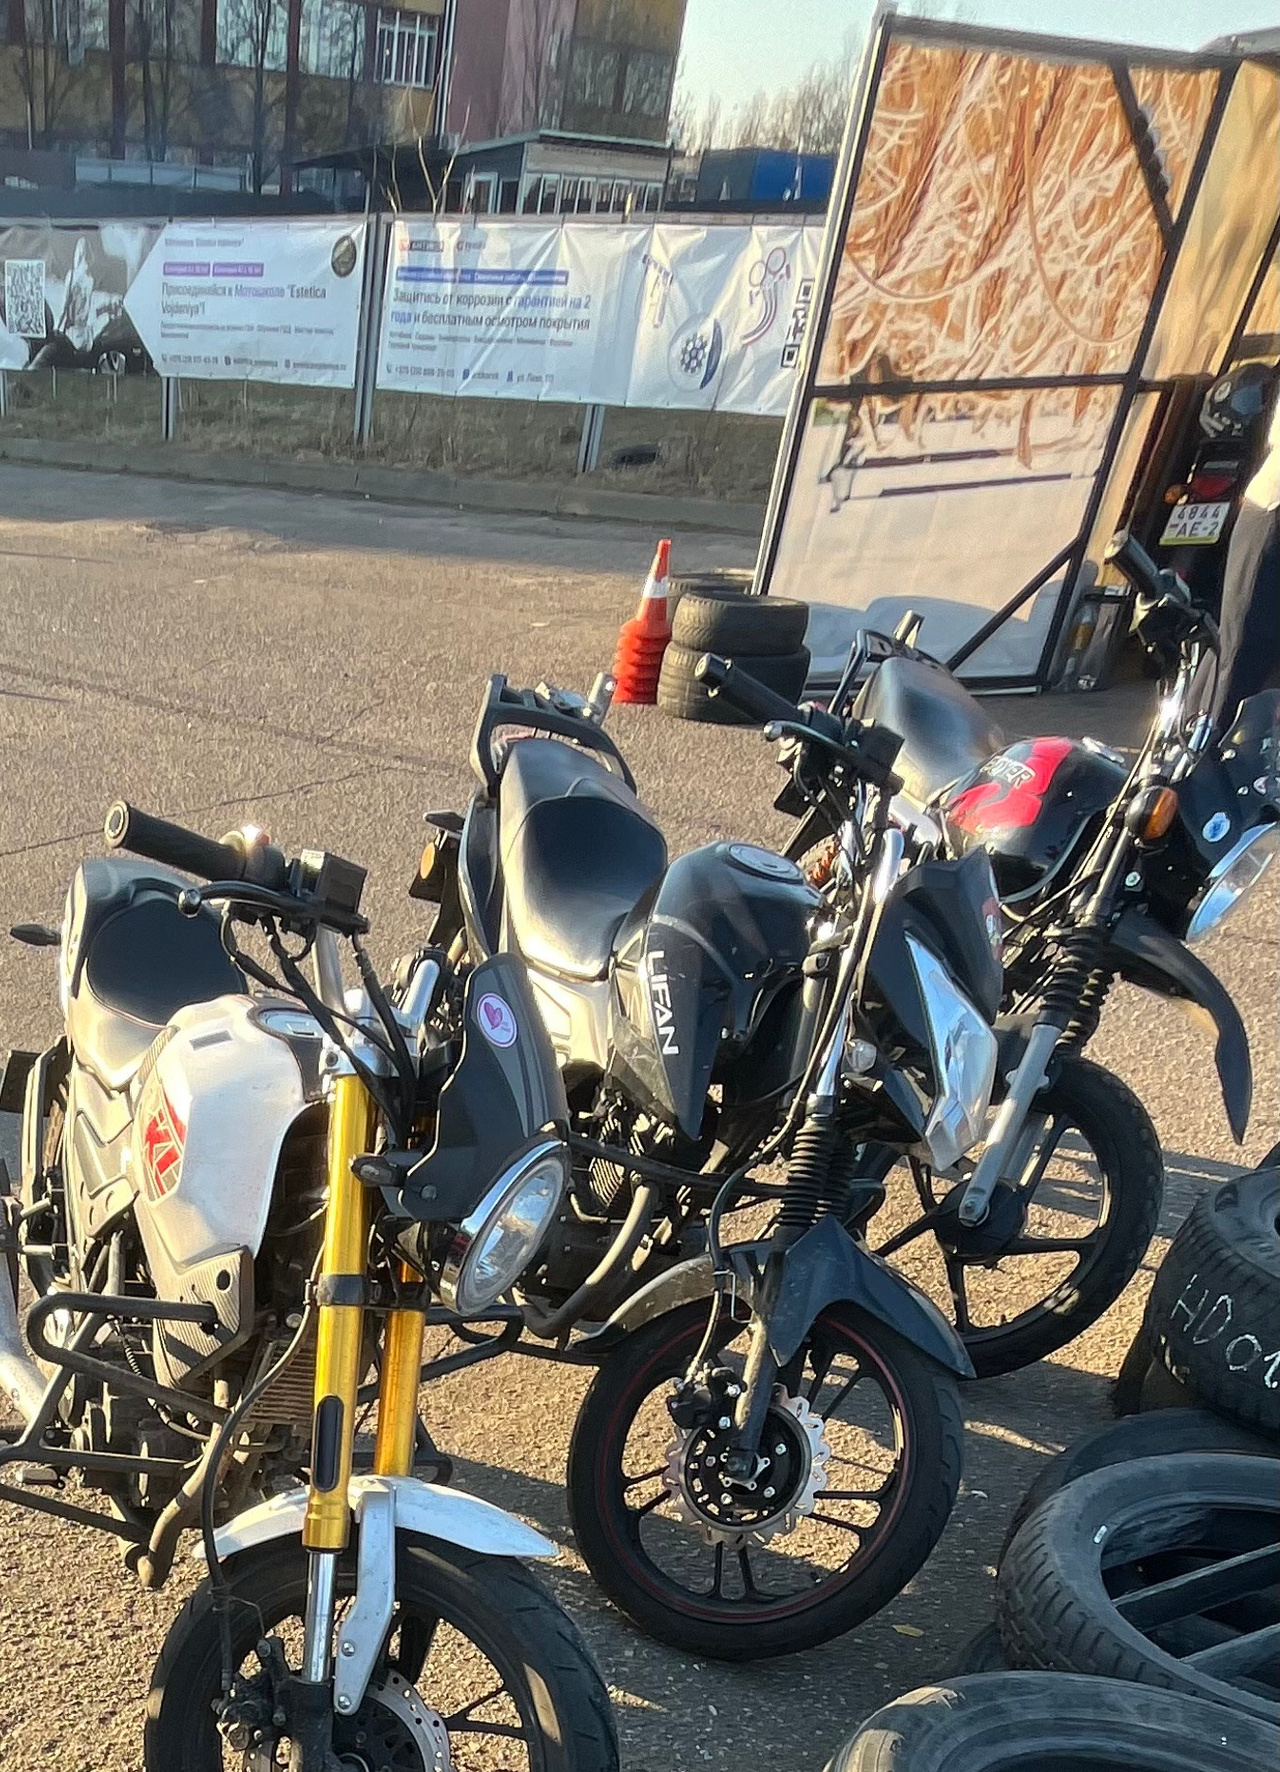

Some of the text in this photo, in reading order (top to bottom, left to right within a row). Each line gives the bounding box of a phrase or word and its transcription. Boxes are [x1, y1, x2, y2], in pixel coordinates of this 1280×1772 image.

[393, 287, 441, 303] Защитись
[442, 293, 453, 305] от
[456, 294, 504, 310] коррозии
[514, 295, 568, 310] гарантией
[569, 297, 582, 308] на
[583, 297, 592, 309] 2
[390, 310, 412, 324] года
[421, 311, 484, 326] бесплатным
[485, 315, 537, 331] осмотром
[538, 317, 591, 334] покрытия
[1177, 504, 1221, 519] 4844
[1175, 521, 1219, 537] AE-2
[647, 949, 679, 1055] LIFAN
